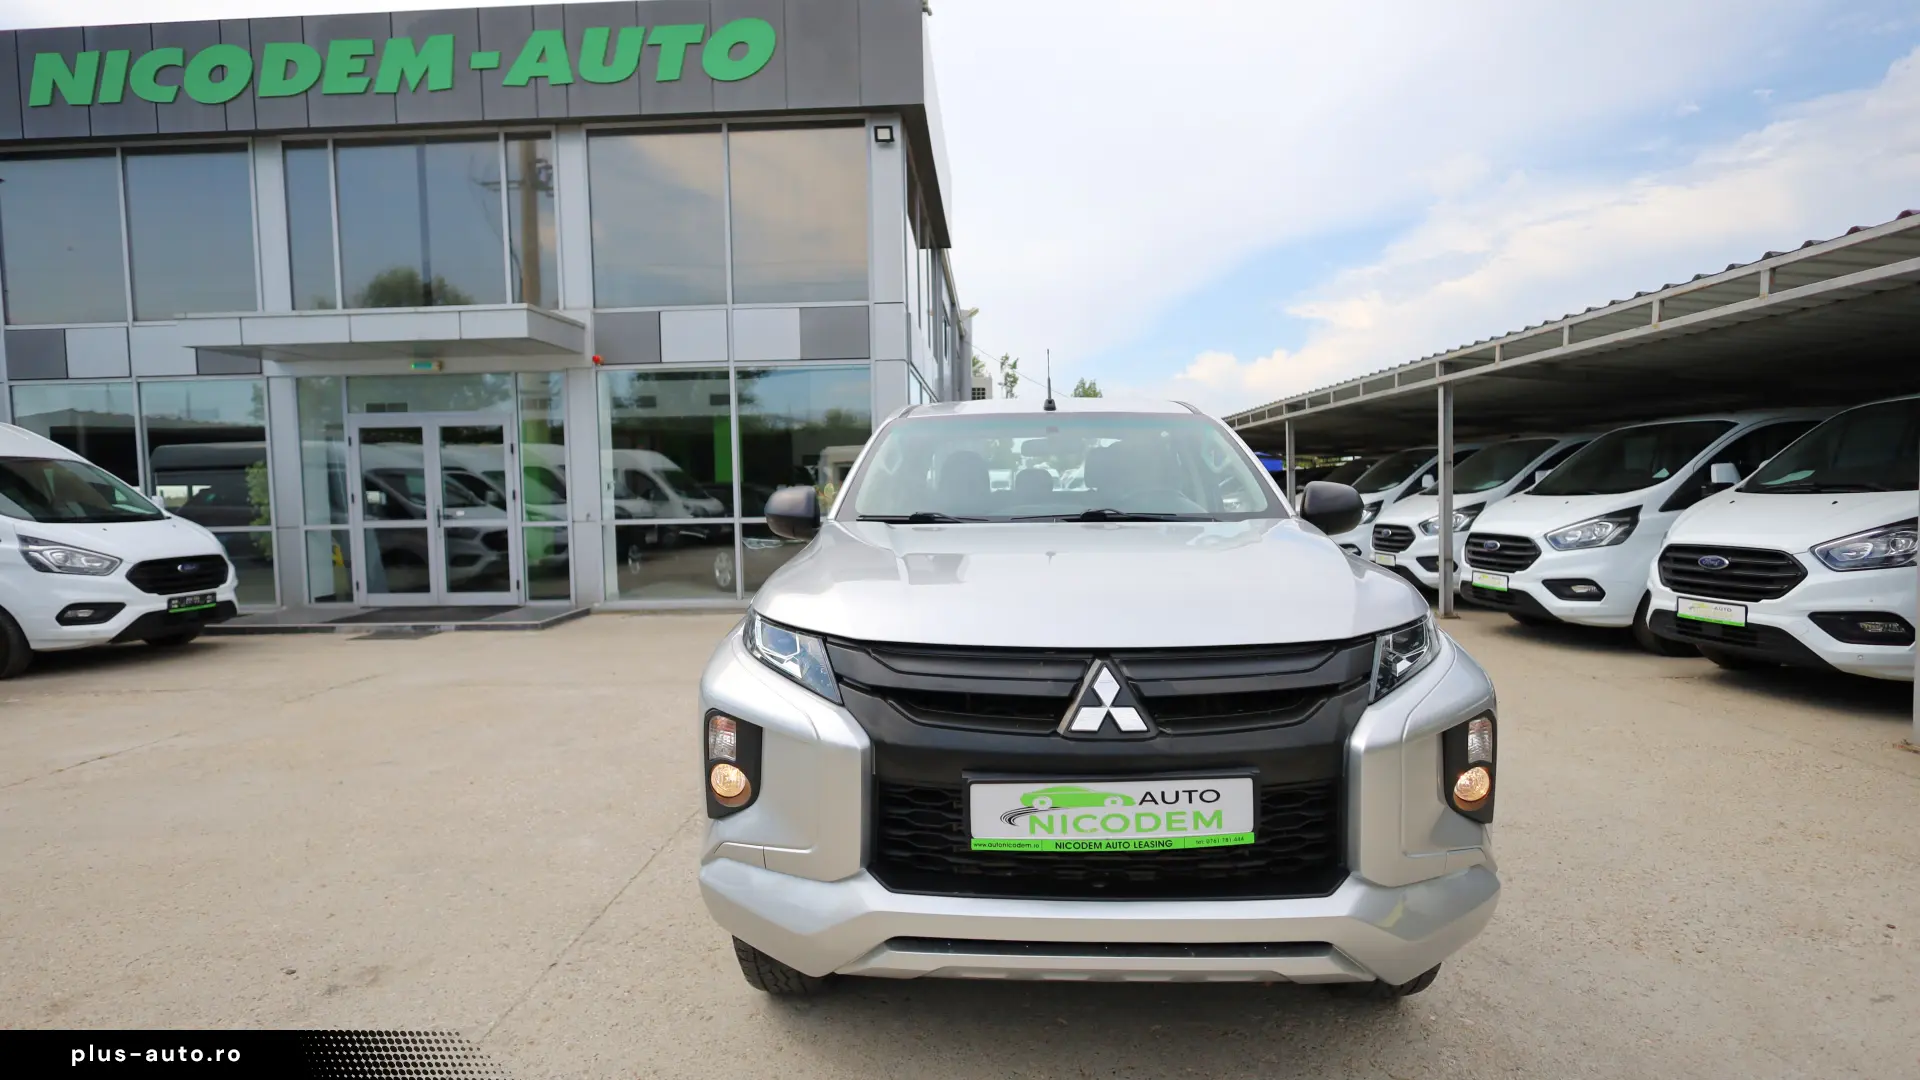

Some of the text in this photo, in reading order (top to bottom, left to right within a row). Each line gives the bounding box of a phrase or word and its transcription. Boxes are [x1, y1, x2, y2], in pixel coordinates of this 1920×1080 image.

[1138, 789, 1221, 806] AUTO
[1029, 809, 1223, 835] NICODEM
[1055, 839, 1173, 850] NICODEM AUTO LEASING
